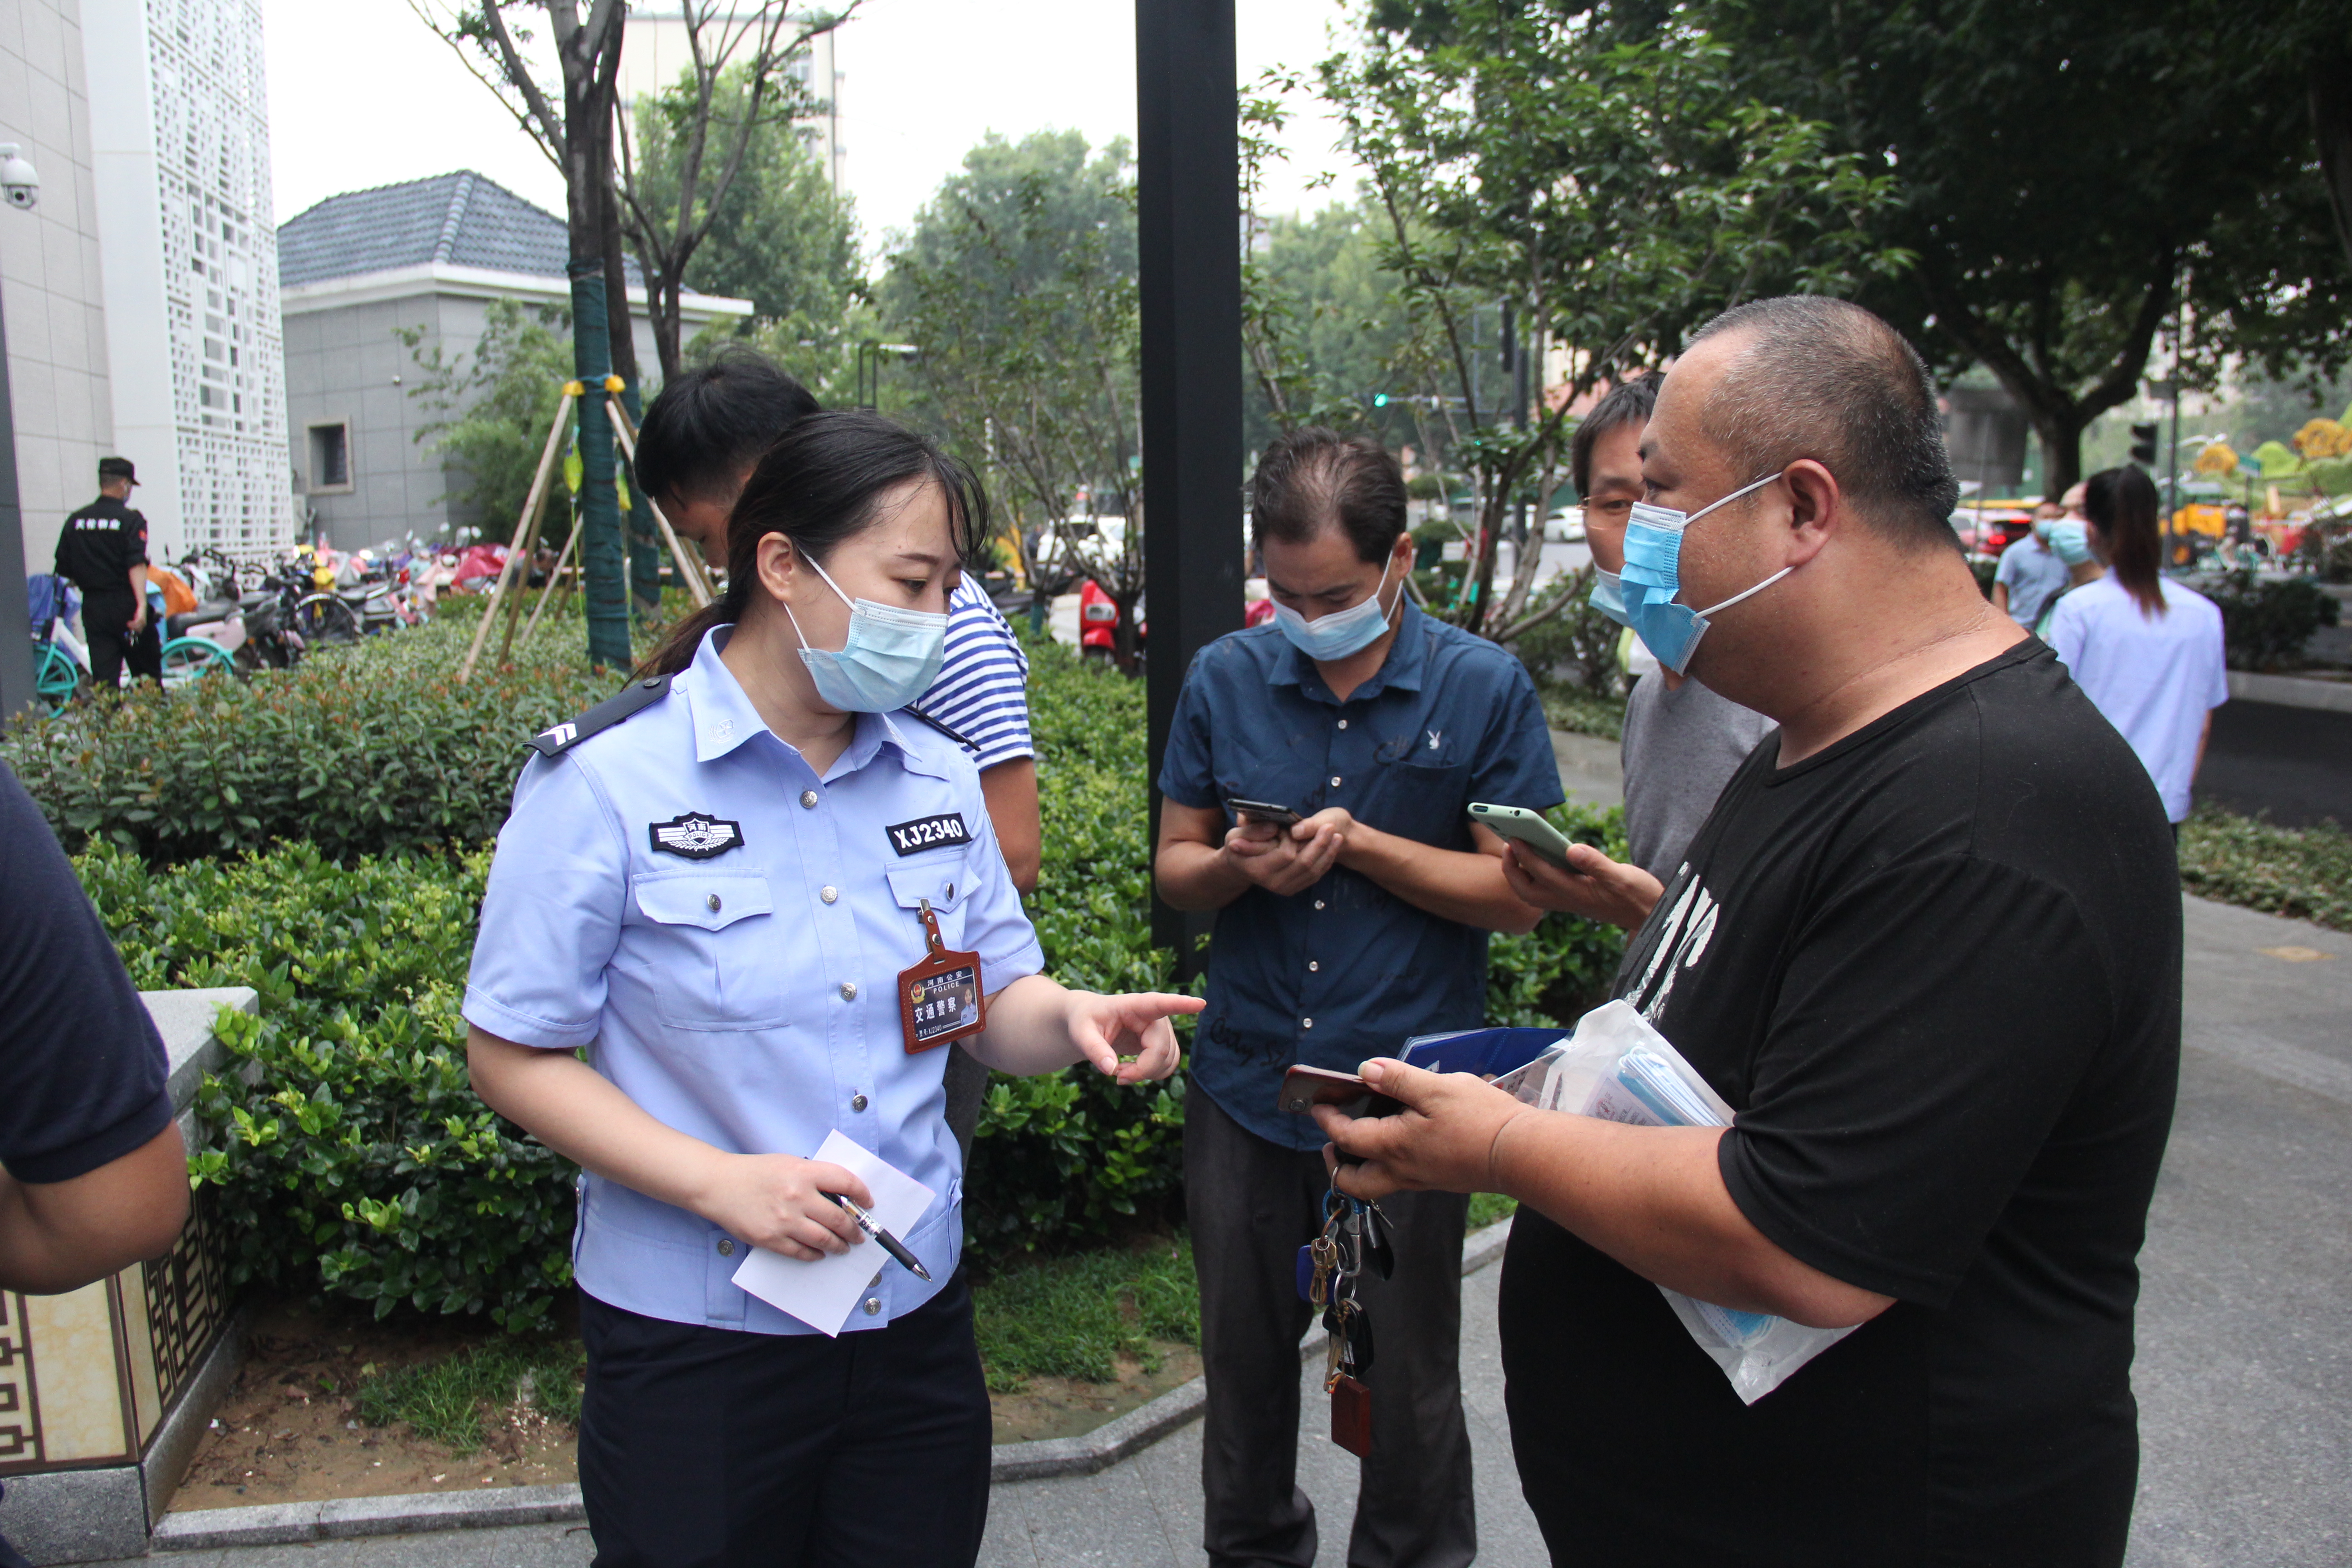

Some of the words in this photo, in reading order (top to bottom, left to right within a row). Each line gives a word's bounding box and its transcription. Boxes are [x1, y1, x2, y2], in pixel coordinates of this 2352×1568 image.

[687, 823, 706, 832] 河南
[894, 819, 963, 849] XJ2340
[927, 970, 962, 987] 河南公安
[933, 981, 960, 994] POLICE
[915, 997, 956, 1024] 交通警察
